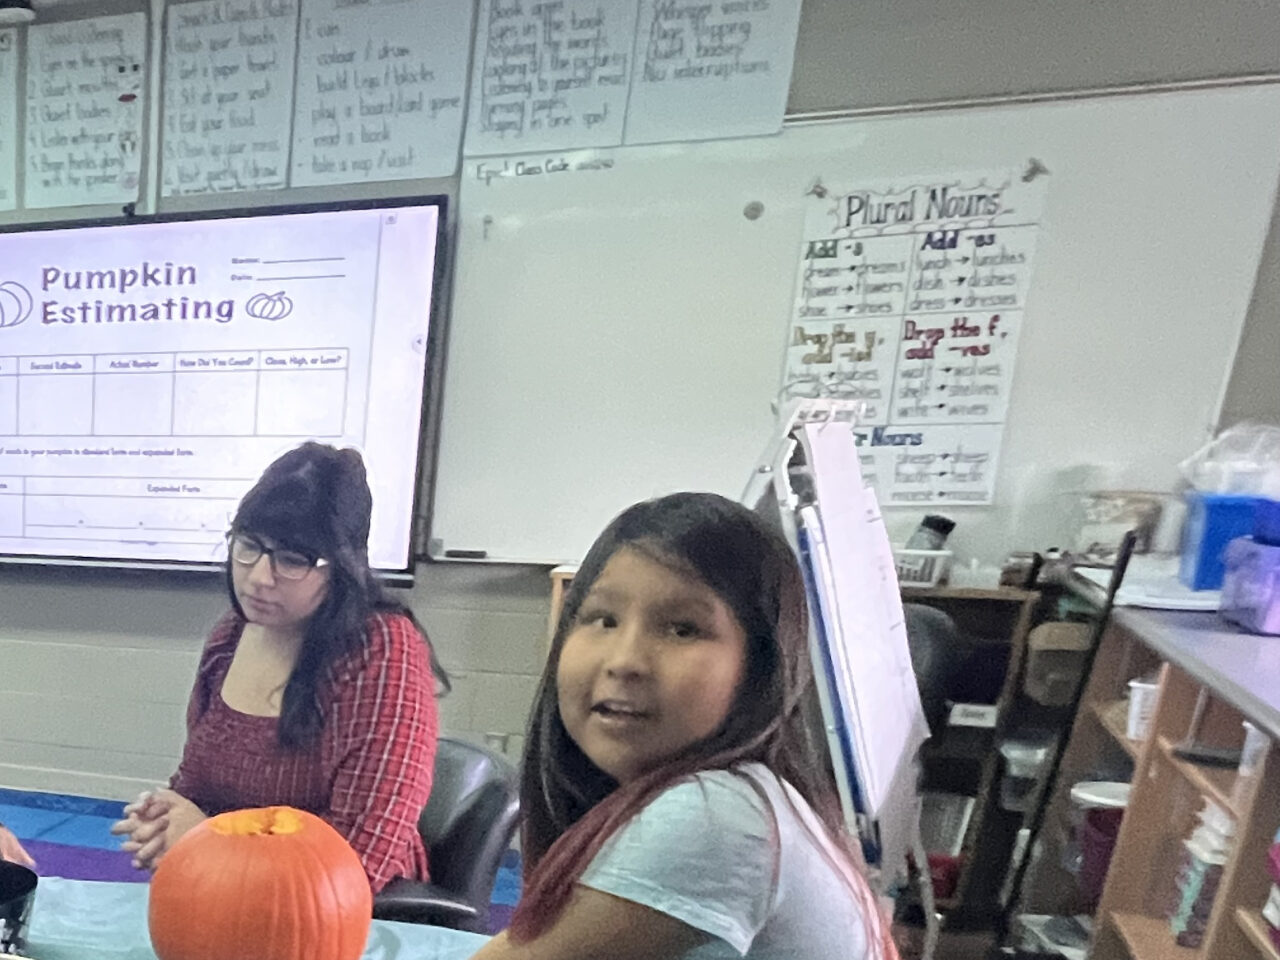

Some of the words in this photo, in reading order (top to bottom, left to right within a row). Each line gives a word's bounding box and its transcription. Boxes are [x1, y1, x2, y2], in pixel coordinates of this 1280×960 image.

[846, 189, 917, 227] Plural
[924, 187, 1001, 221] Nouns
[805, 240, 838, 260] Add
[922, 230, 960, 251] Add
[41, 261, 197, 293] Pumpkin
[41, 296, 235, 325] Estimating
[902, 320, 945, 346] Drop
[950, 316, 981, 338] the
[871, 426, 924, 447] Nouns
